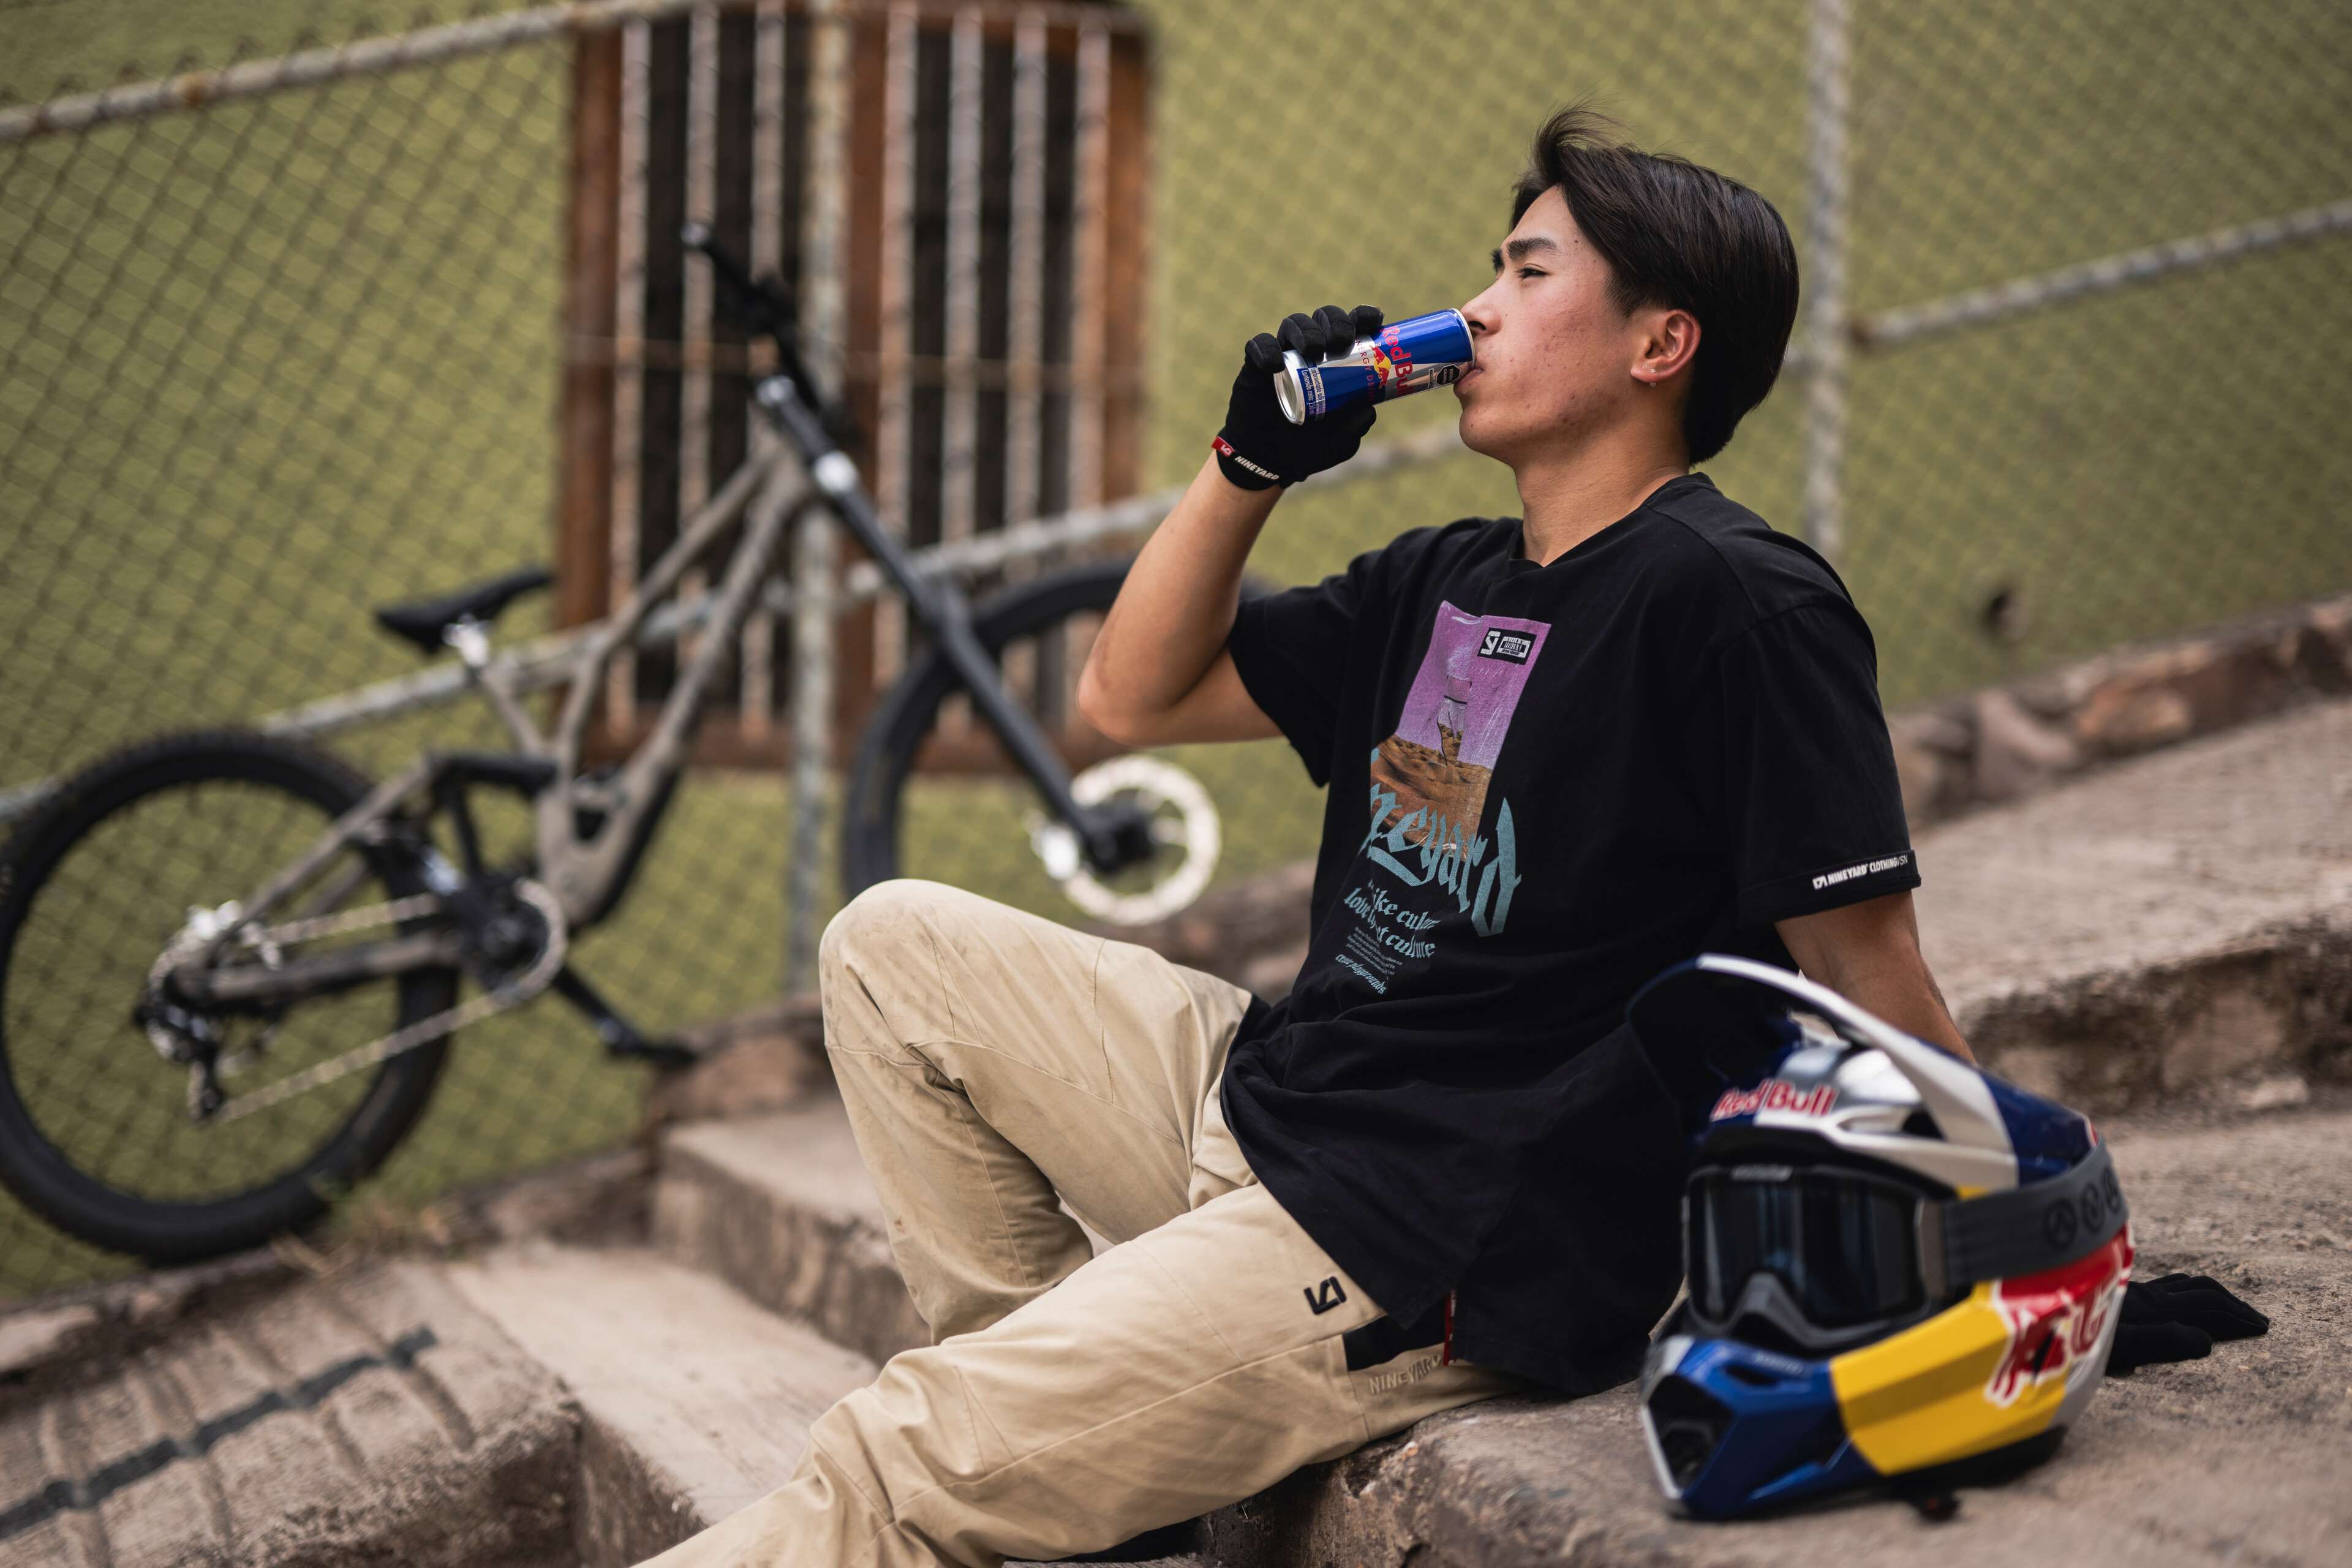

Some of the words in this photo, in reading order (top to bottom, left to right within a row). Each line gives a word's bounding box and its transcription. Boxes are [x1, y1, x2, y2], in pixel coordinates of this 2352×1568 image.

[1380, 325, 1412, 362] Red
[1235, 456, 1280, 480] NINEYARD
[1827, 864, 1868, 885] NINEYARD
[1709, 1078, 1770, 1122] Red
[1764, 1080, 1839, 1117] Bull
